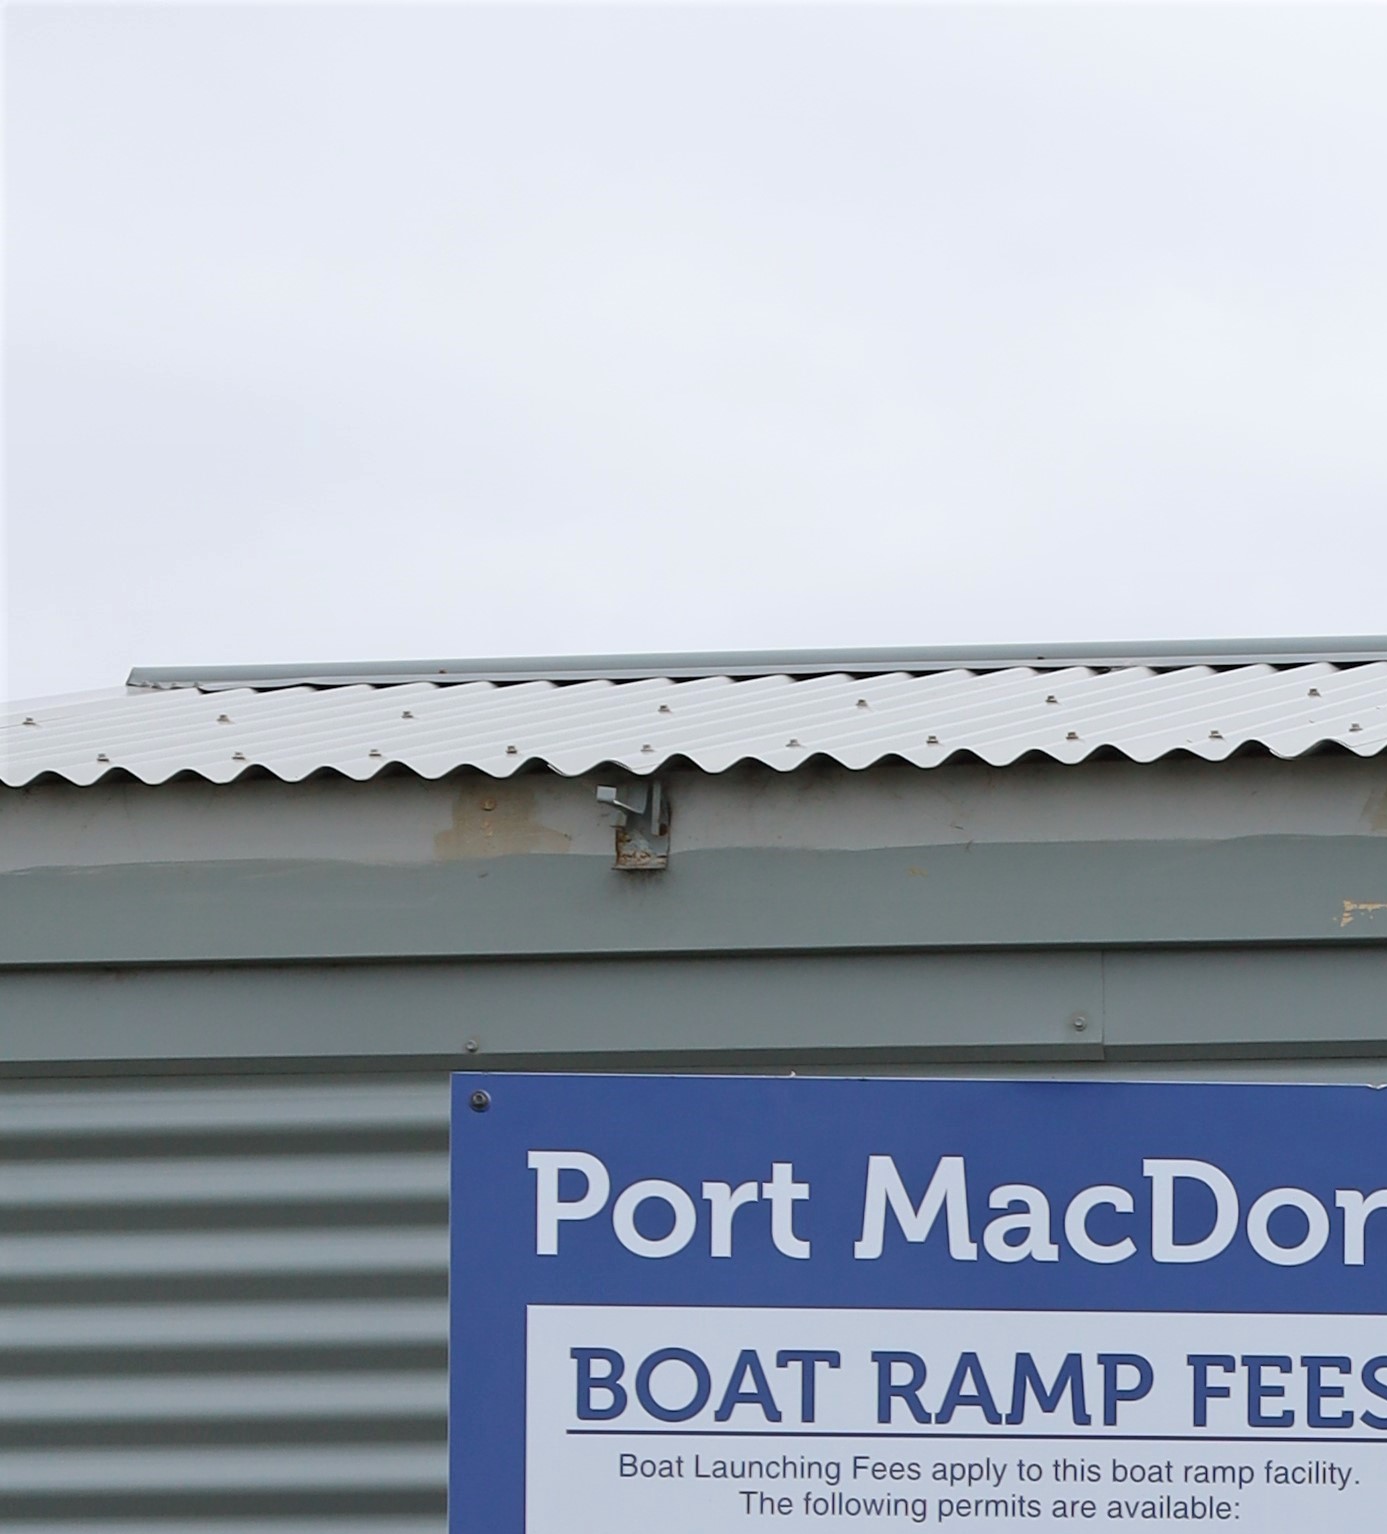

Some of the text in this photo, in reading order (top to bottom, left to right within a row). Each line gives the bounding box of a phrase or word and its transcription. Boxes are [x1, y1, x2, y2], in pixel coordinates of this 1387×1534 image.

[528, 1151, 809, 1258] Port
[570, 1348, 840, 1423] BOAT
[871, 1351, 1154, 1426] RAMP
[620, 1454, 1359, 1491] Boat Launching Fees apply to this boat ramp facility.
[739, 1491, 1239, 1523] The following permits are available:
